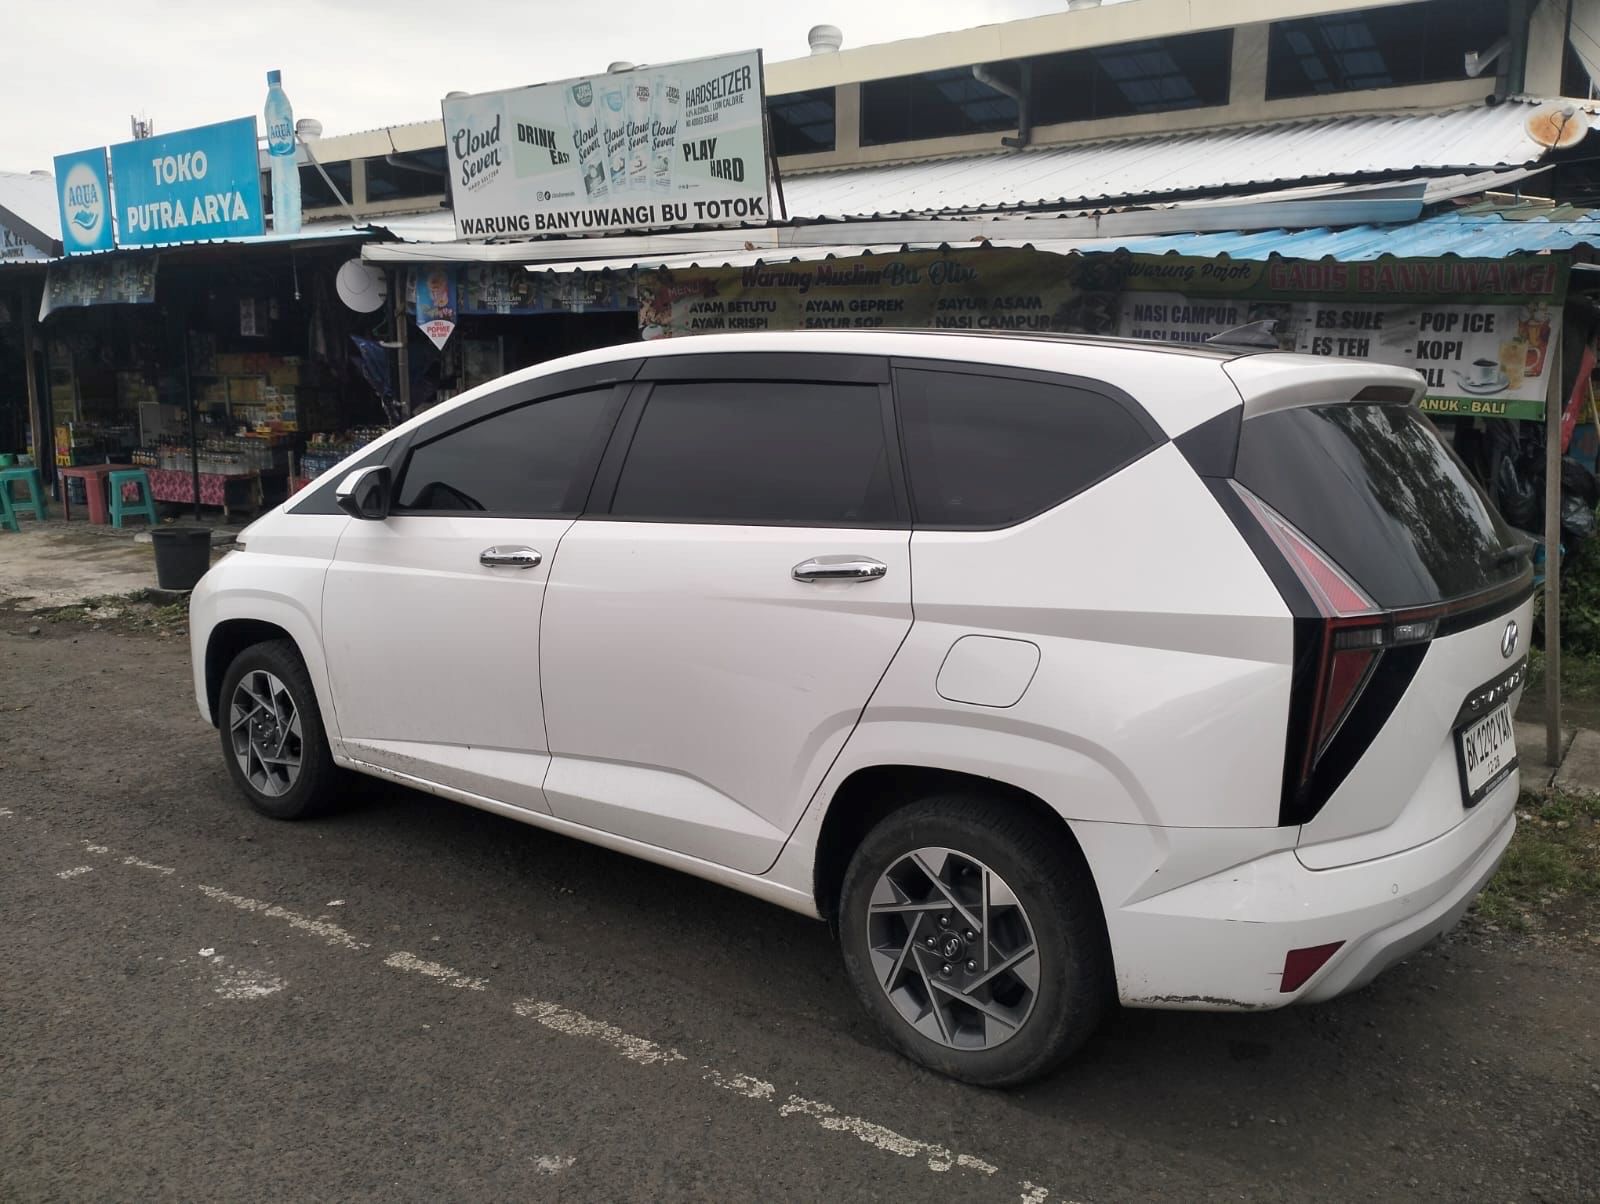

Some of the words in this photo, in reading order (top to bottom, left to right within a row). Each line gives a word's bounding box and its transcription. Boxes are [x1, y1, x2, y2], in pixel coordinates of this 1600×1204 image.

[685, 65, 752, 108] HARDSELTZER
[270, 122, 291, 140] AQUA
[452, 113, 500, 160] Cloud
[516, 122, 557, 150] DRINK
[573, 116, 598, 150] Cloud
[603, 121, 625, 145] Cloud
[626, 116, 650, 138] Cloud
[651, 120, 678, 138] Cloud
[578, 138, 601, 165] Seven
[607, 138, 625, 158] Seven
[628, 134, 649, 152] Seven
[651, 136, 675, 152] Seven
[682, 136, 718, 162] PLAY
[152, 149, 208, 186] TOKO
[461, 147, 502, 186] Seven
[709, 156, 745, 183] HARD
[68, 184, 99, 208] AQUA
[127, 199, 192, 234] PUTRA
[190, 190, 249, 223] ARYA
[460, 214, 530, 235] WARUNG
[535, 205, 655, 231] BANYUWANGI
[661, 203, 688, 221] BU
[693, 197, 765, 220] TOTOK
[741, 266, 811, 293] Warung
[815, 263, 881, 287] Muslim
[1127, 262, 1195, 281] Warung
[1200, 262, 1252, 281] Pojok
[1269, 263, 1349, 292] GADIS
[1356, 262, 1559, 293] BANYUWANGI
[689, 301, 725, 313] AYAM
[728, 301, 776, 313] BETUTU
[805, 300, 845, 313] AYAM
[848, 299, 904, 313] GEPREK
[993, 295, 1043, 310] ASAM
[690, 317, 725, 329] AYAM
[728, 317, 768, 329] KRISPI
[805, 316, 850, 329] SAYUR
[936, 315, 972, 329] NASI
[977, 315, 1051, 330] CAMPUR
[1133, 304, 1167, 323] NASI
[1172, 305, 1237, 325] CAMPUR
[1315, 310, 1337, 329] ES
[1340, 310, 1384, 330] SULE
[1418, 312, 1459, 333] POP
[1463, 313, 1495, 333] ICE
[1311, 337, 1333, 356] ES
[1337, 338, 1370, 358] TEH
[1416, 340, 1463, 361] KOPI
[1471, 401, 1506, 414] BALI
[1477, 717, 1498, 763] 1292
